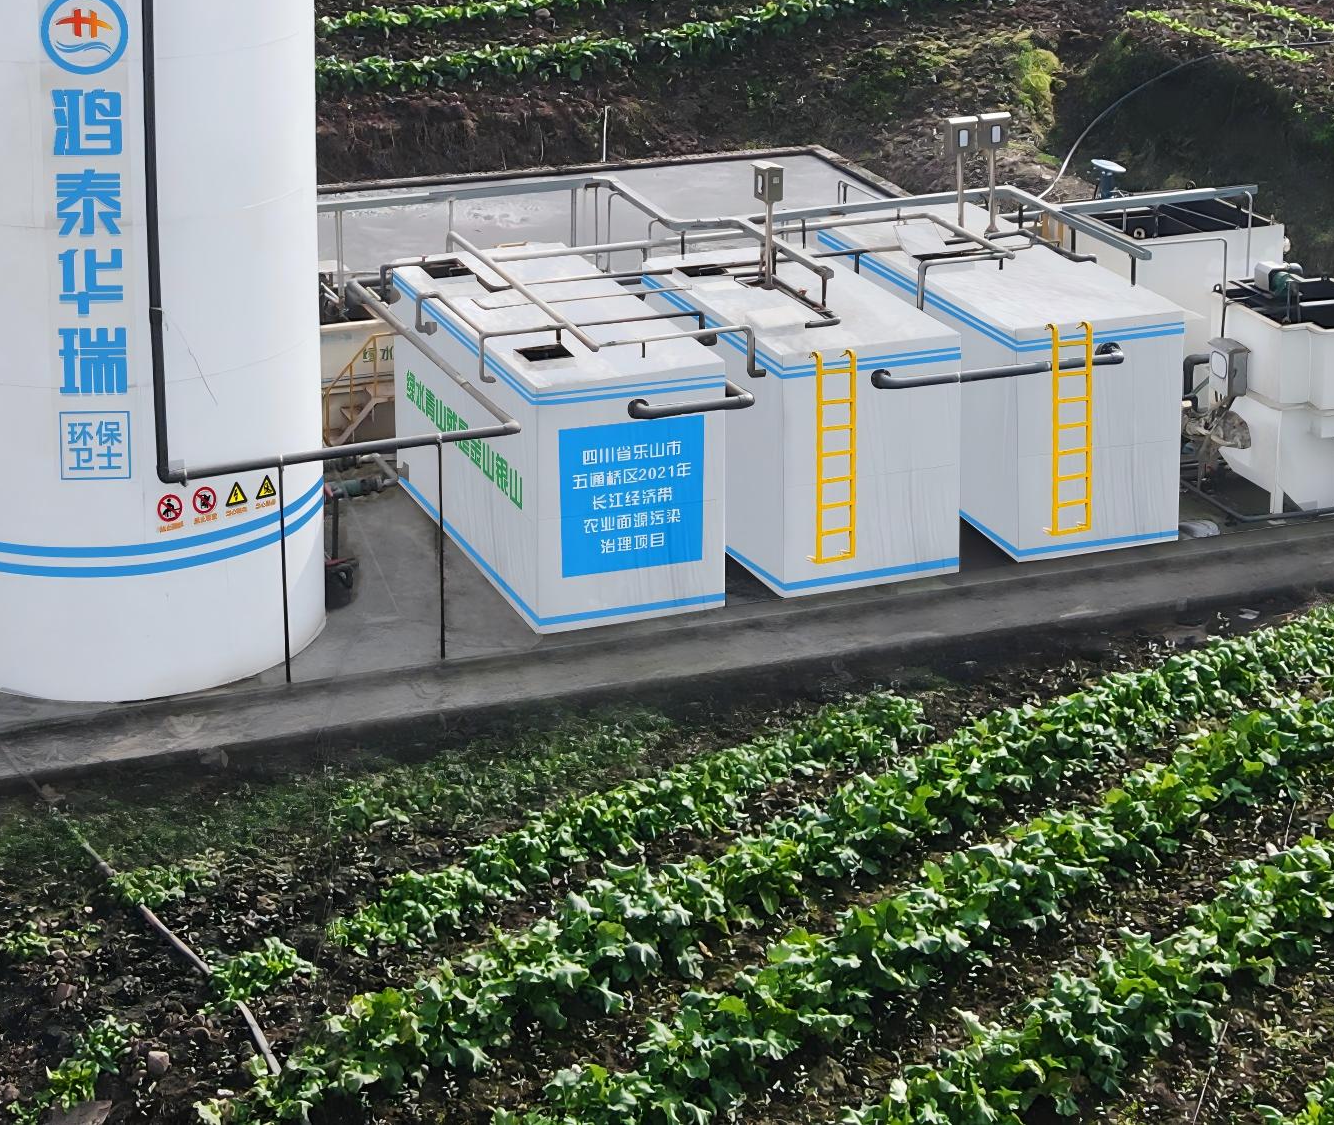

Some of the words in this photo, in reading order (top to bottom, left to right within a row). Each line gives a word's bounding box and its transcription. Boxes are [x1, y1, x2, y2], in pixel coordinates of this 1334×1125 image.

[50, 88, 129, 396] 鸿泰华瑞
[67, 420, 122, 446] 环保
[68, 446, 123, 471] 卫士
[582, 440, 682, 466] 四川省乐山市
[572, 462, 692, 490] 五通桥区2021年
[592, 486, 673, 511] 长江经济带
[583, 508, 681, 534] 农业面源污染
[600, 532, 665, 554] 治理项目
